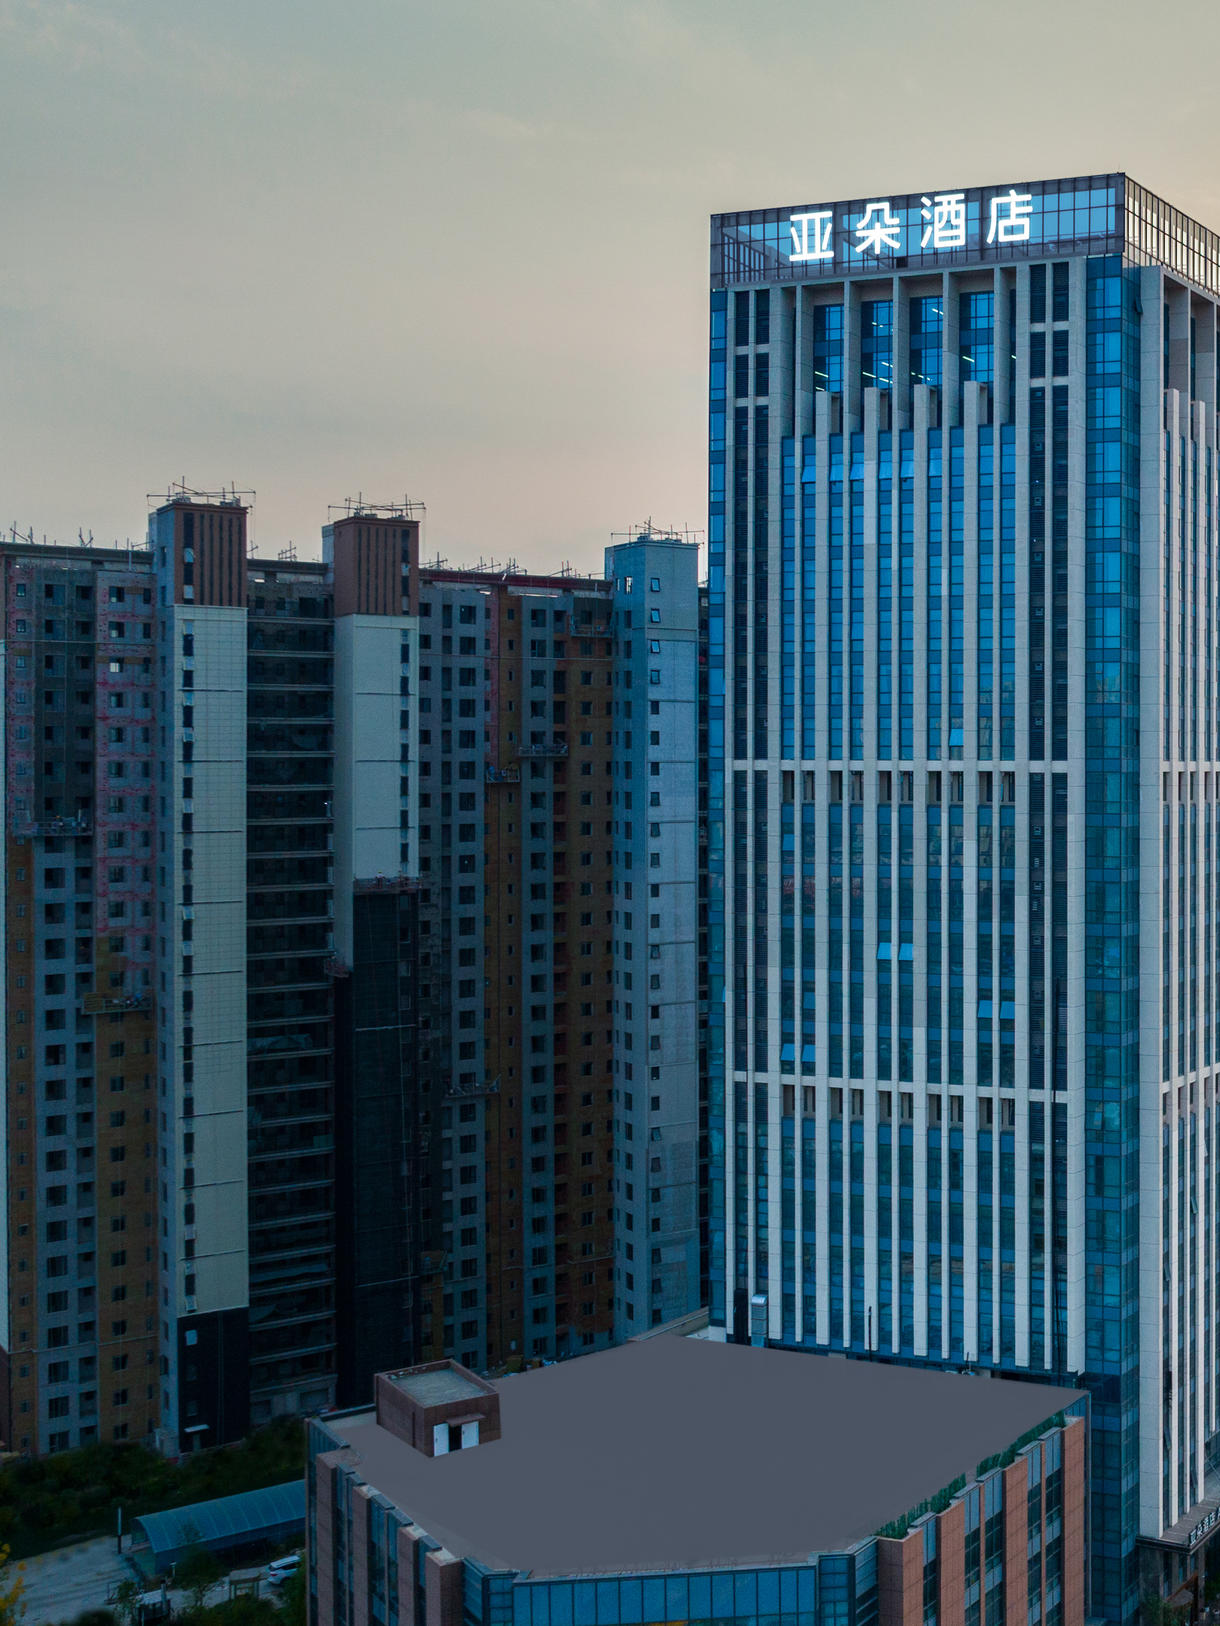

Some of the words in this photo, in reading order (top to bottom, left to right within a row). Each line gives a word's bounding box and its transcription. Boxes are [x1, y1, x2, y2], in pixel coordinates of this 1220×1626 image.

[789, 189, 1033, 262] 亚朵酒店
[1190, 1512, 1215, 1545] 亚朵酒店
